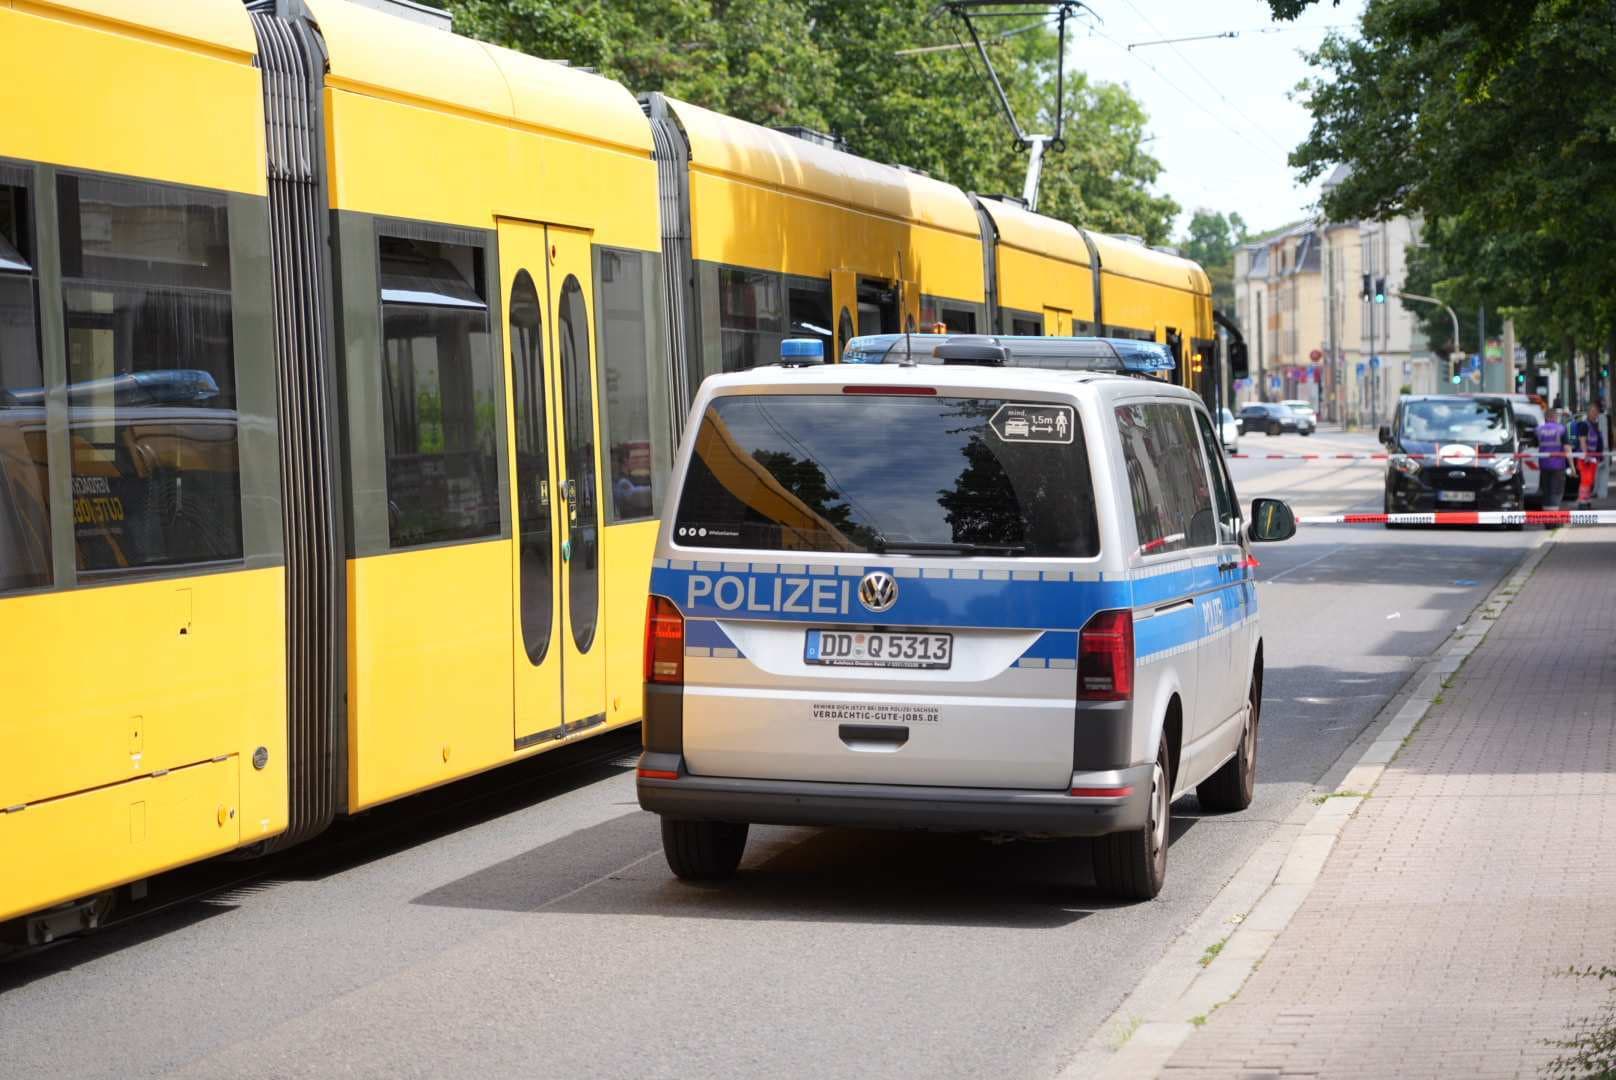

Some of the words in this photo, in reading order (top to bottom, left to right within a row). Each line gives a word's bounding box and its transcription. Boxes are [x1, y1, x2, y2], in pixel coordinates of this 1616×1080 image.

[1008, 409, 1027, 417] mind.
[1032, 415, 1053, 425] 1,5m
[687, 575, 849, 615] POLIZEI
[821, 634, 852, 657] DD
[867, 635, 883, 658] Q
[888, 636, 948, 660] 5313
